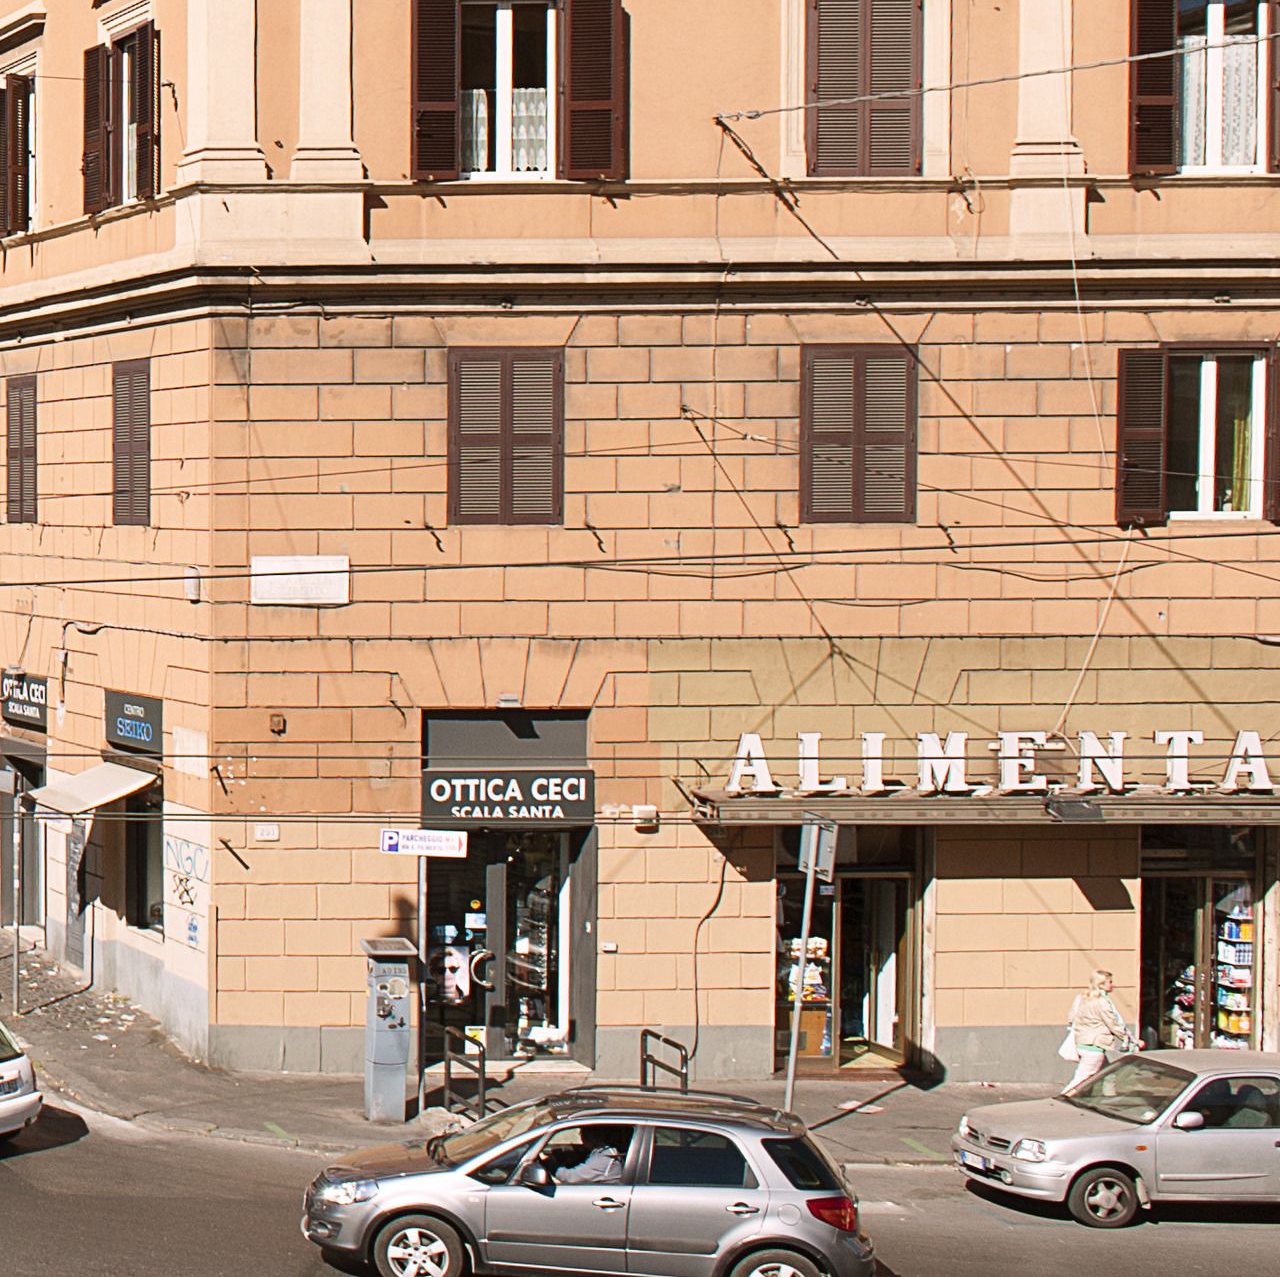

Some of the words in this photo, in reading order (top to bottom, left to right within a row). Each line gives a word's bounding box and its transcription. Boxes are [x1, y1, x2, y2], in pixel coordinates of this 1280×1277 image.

[29, 683, 46, 705] CECI
[8, 701, 23, 715] SCALA
[23, 705, 40, 719] SANTA
[124, 703, 145, 718] CENTRO
[116, 717, 153, 742] SEIKO
[724, 729, 1274, 794] ALIMENTA
[430, 778, 524, 802] OTTICA
[531, 777, 587, 802] CECI
[451, 806, 504, 818] SCALA
[508, 805, 565, 818] SANTA
